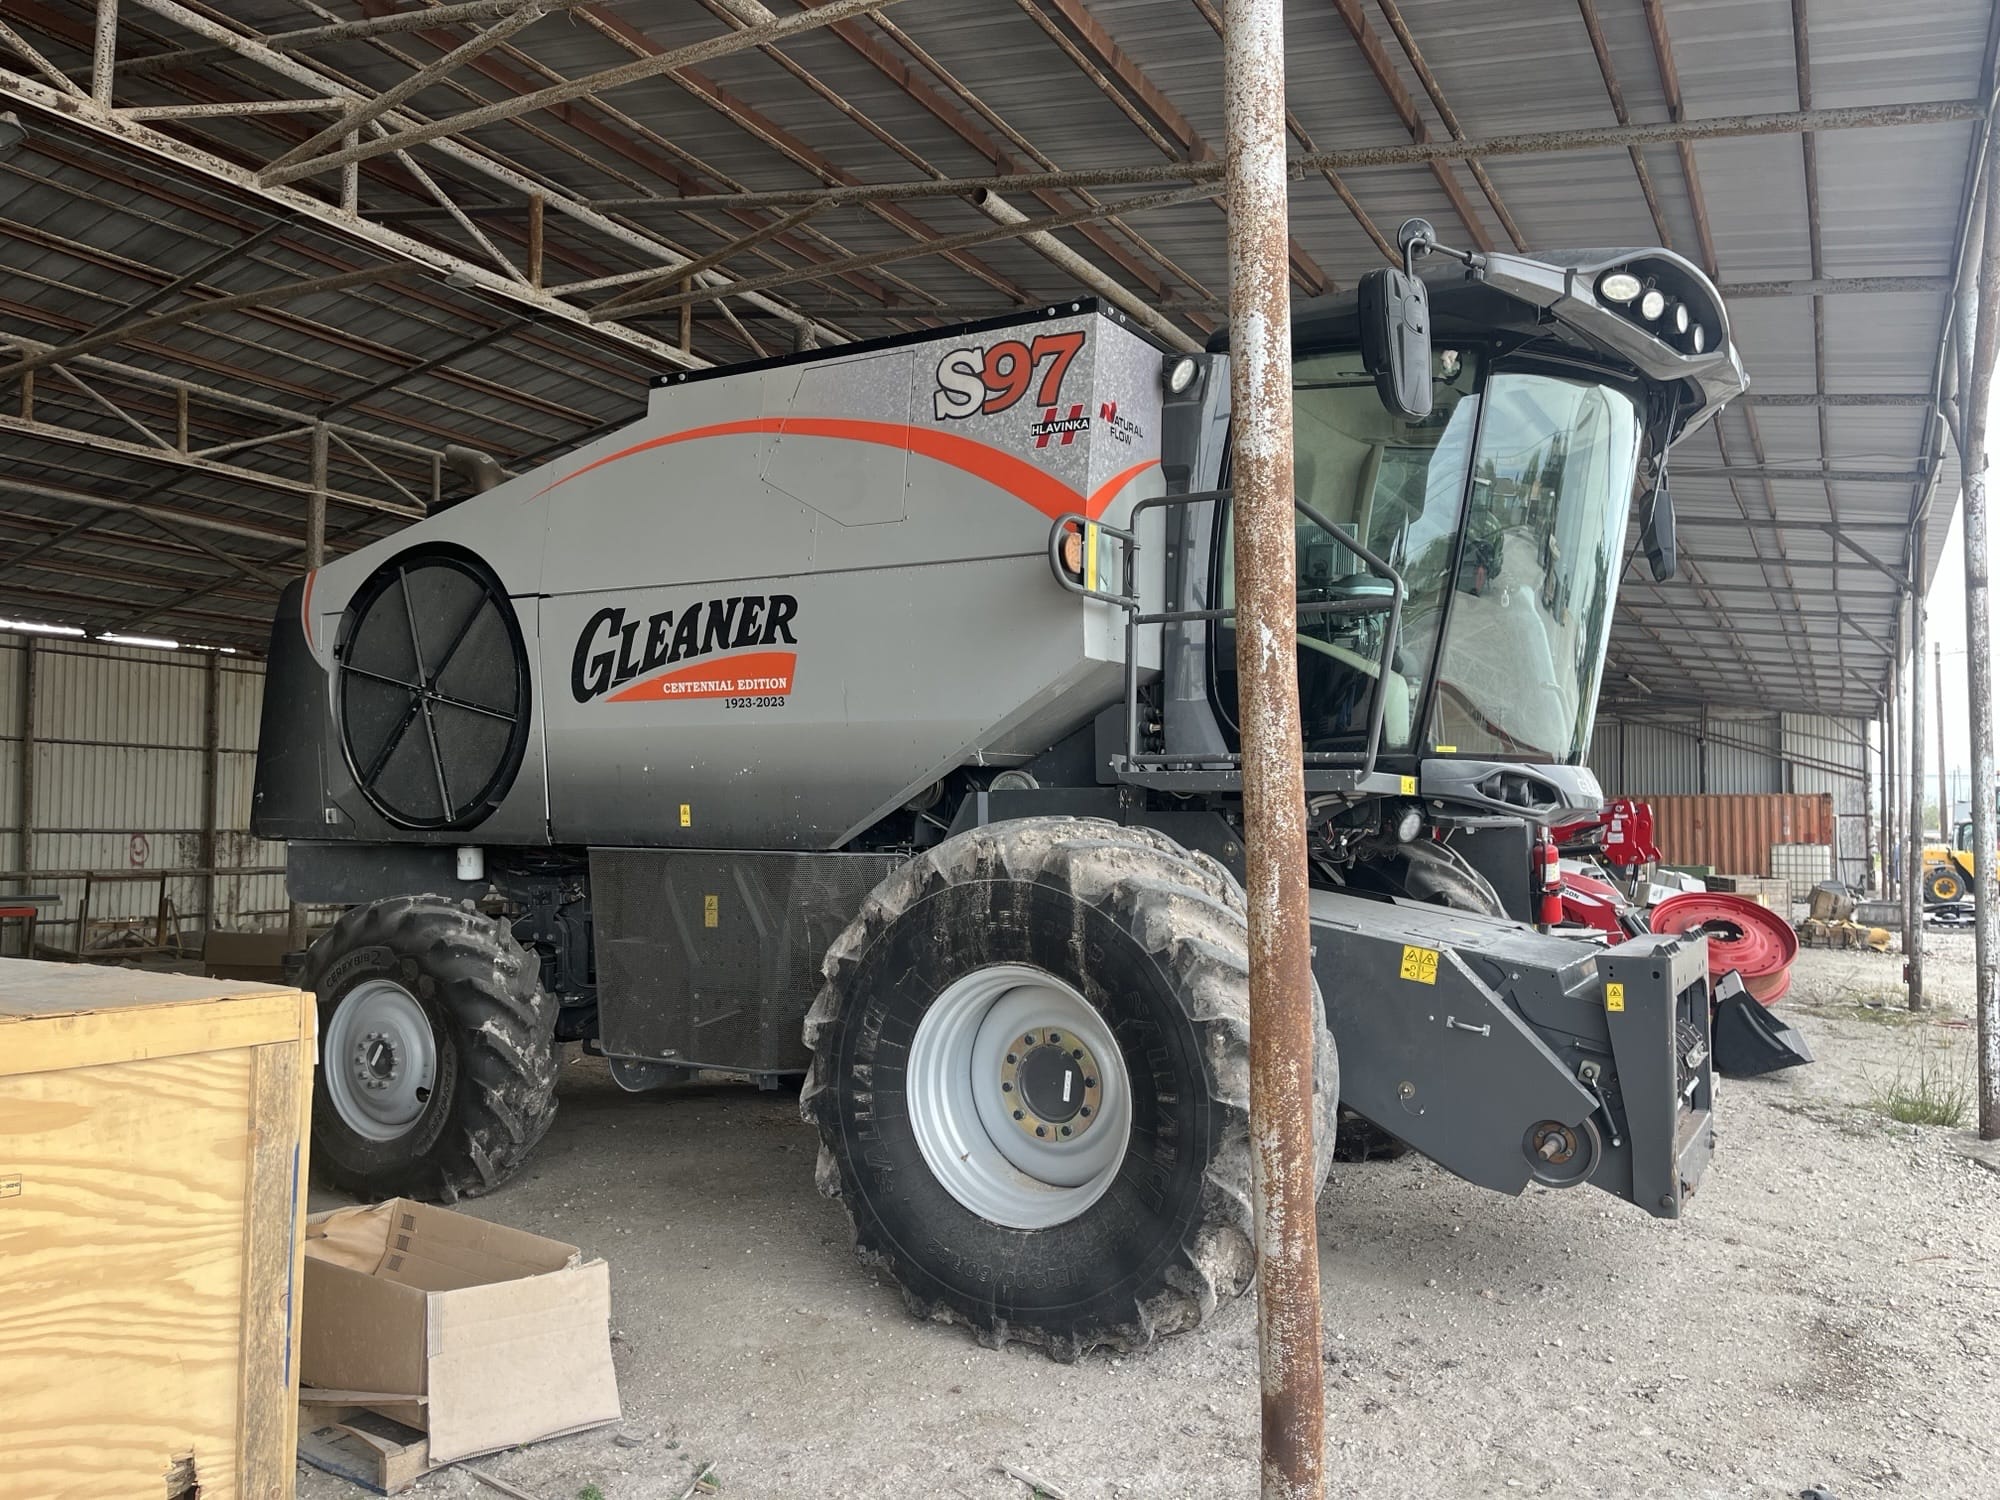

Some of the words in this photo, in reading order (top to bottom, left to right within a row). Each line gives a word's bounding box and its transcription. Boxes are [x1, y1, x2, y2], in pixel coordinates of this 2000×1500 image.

[934, 331, 1085, 421] S97
[1032, 419, 1089, 436] HLAVINKA
[1100, 400, 1144, 439] NATURAL
[1110, 428, 1132, 446] FLOW
[571, 594, 798, 704] GLEANER
[663, 679, 734, 694] CENTENNIAL
[738, 677, 787, 691] EDITION
[725, 696, 785, 709] 1923-2023
